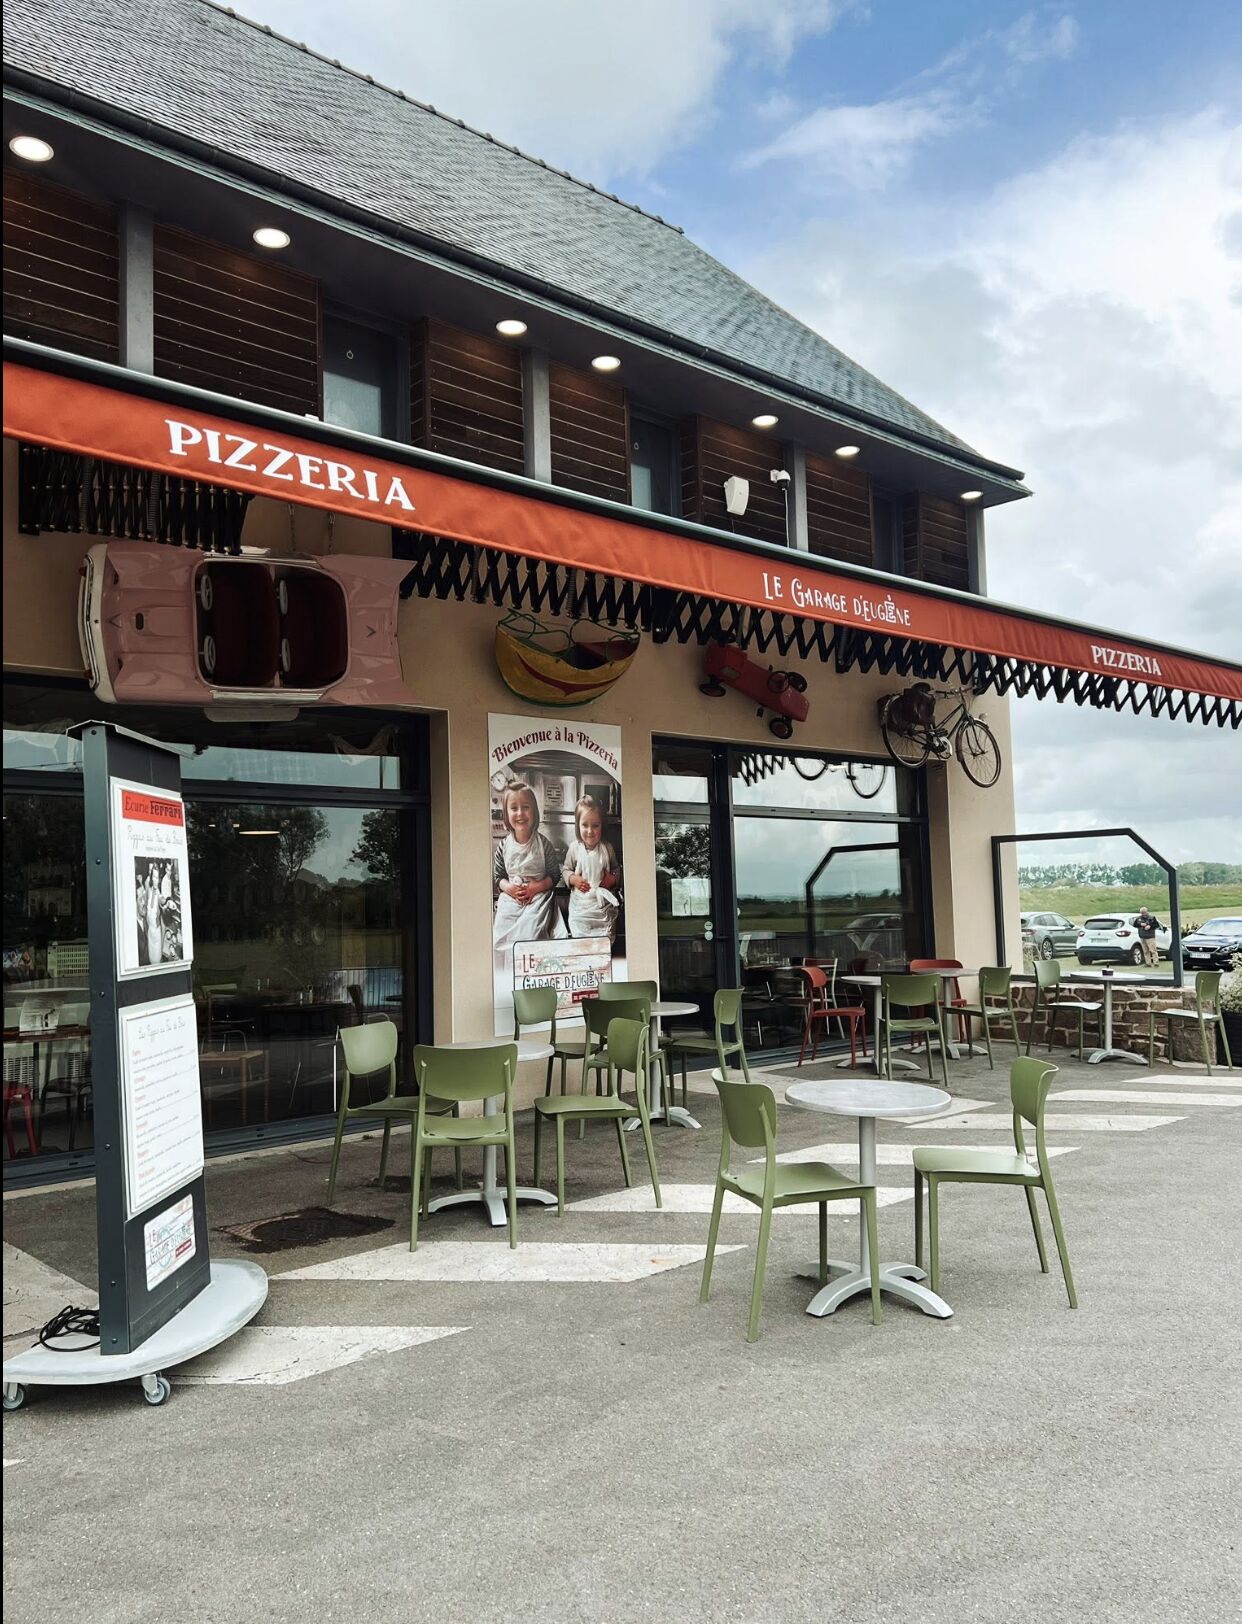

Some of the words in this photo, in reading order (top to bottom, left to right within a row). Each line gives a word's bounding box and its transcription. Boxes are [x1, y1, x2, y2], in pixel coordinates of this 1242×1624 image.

[165, 419, 416, 511] PIZZERIA
[762, 572, 783, 600] LE
[791, 578, 848, 613] GARAGE
[1090, 645, 1162, 676] PIZZERIA
[492, 730, 552, 762] Bienvenue
[555, 727, 561, 741] à
[564, 727, 574, 743] la
[577, 731, 618, 770] Pizzeria
[125, 796, 149, 814] Ecurie
[150, 801, 181, 819] Ferrari
[522, 953, 535, 973] LE
